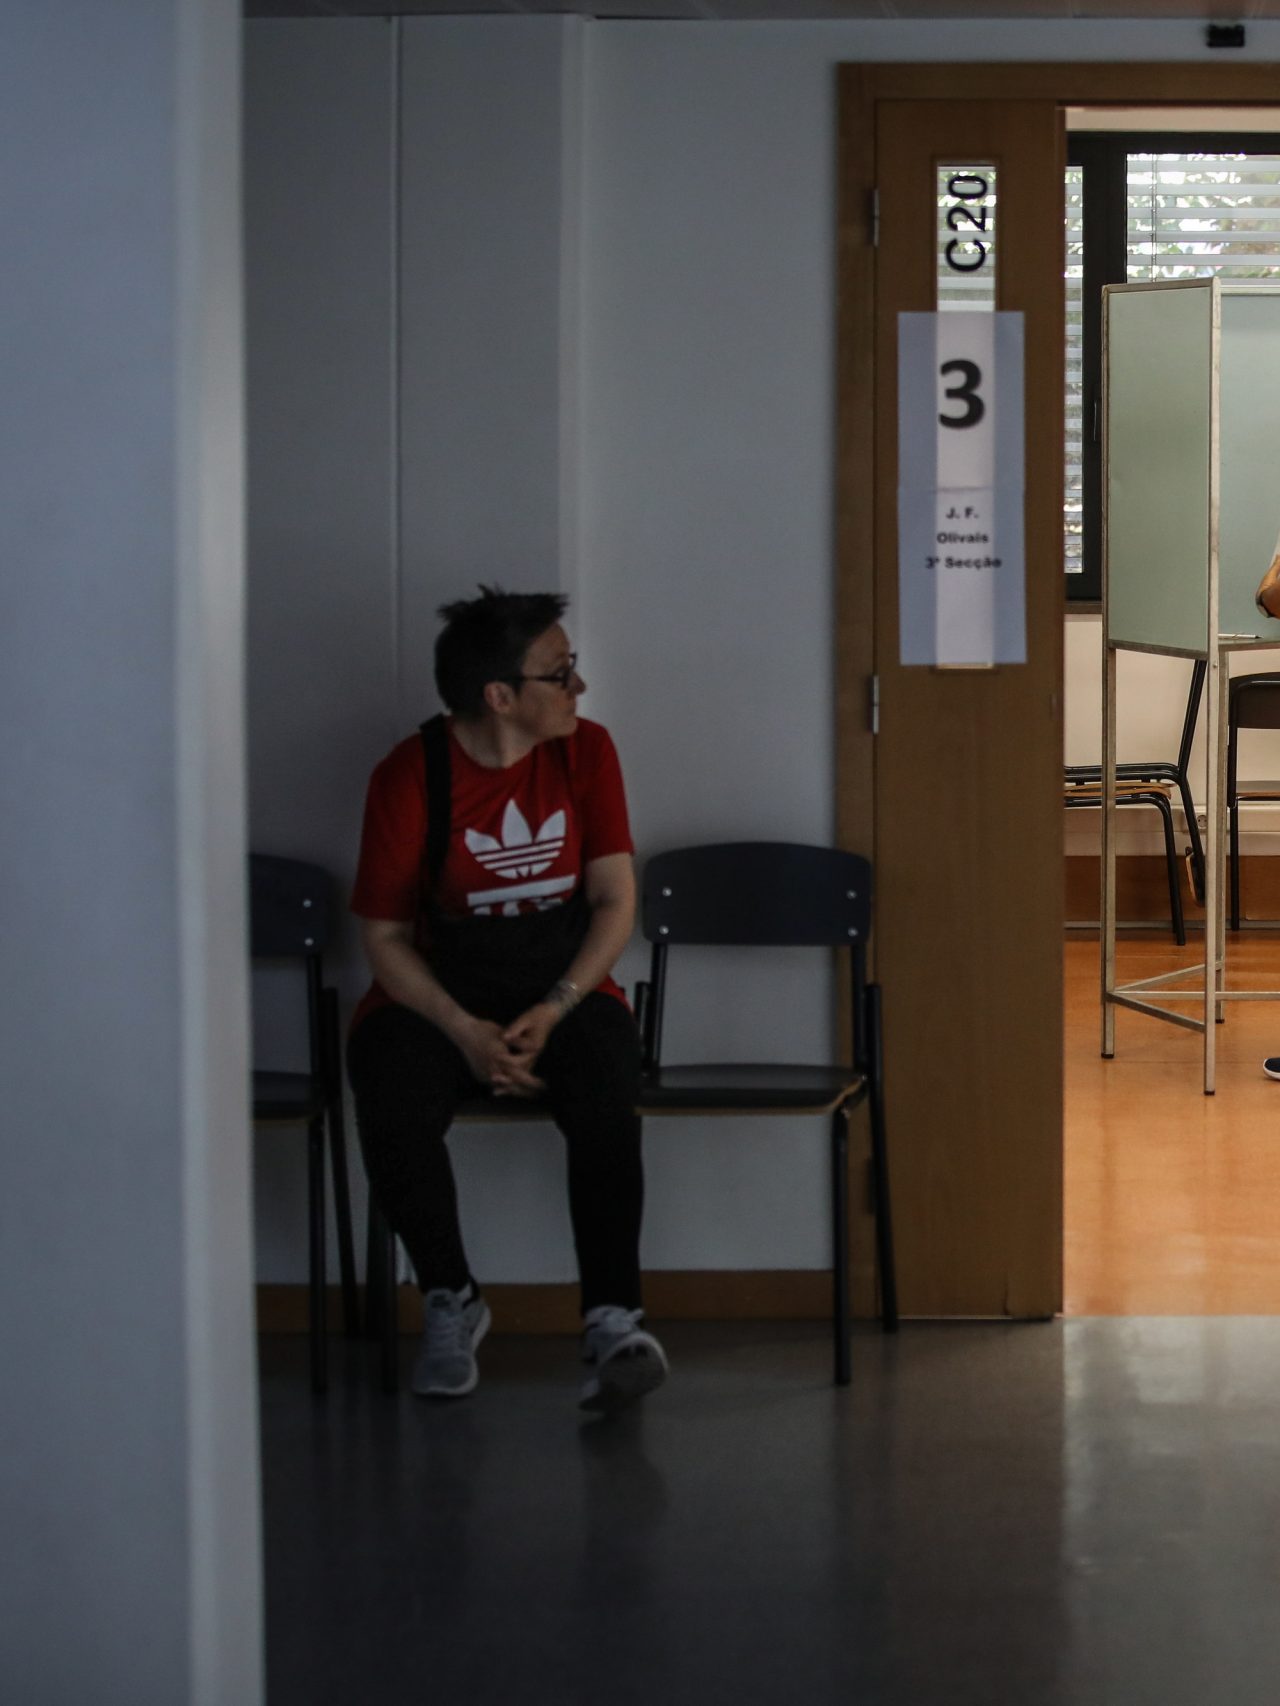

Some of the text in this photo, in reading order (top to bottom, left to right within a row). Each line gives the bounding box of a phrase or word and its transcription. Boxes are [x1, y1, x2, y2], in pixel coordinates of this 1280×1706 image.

[945, 175, 988, 272] C20
[938, 358, 986, 430] 3
[937, 532, 989, 544] Olivais
[945, 555, 1003, 571] Secção
